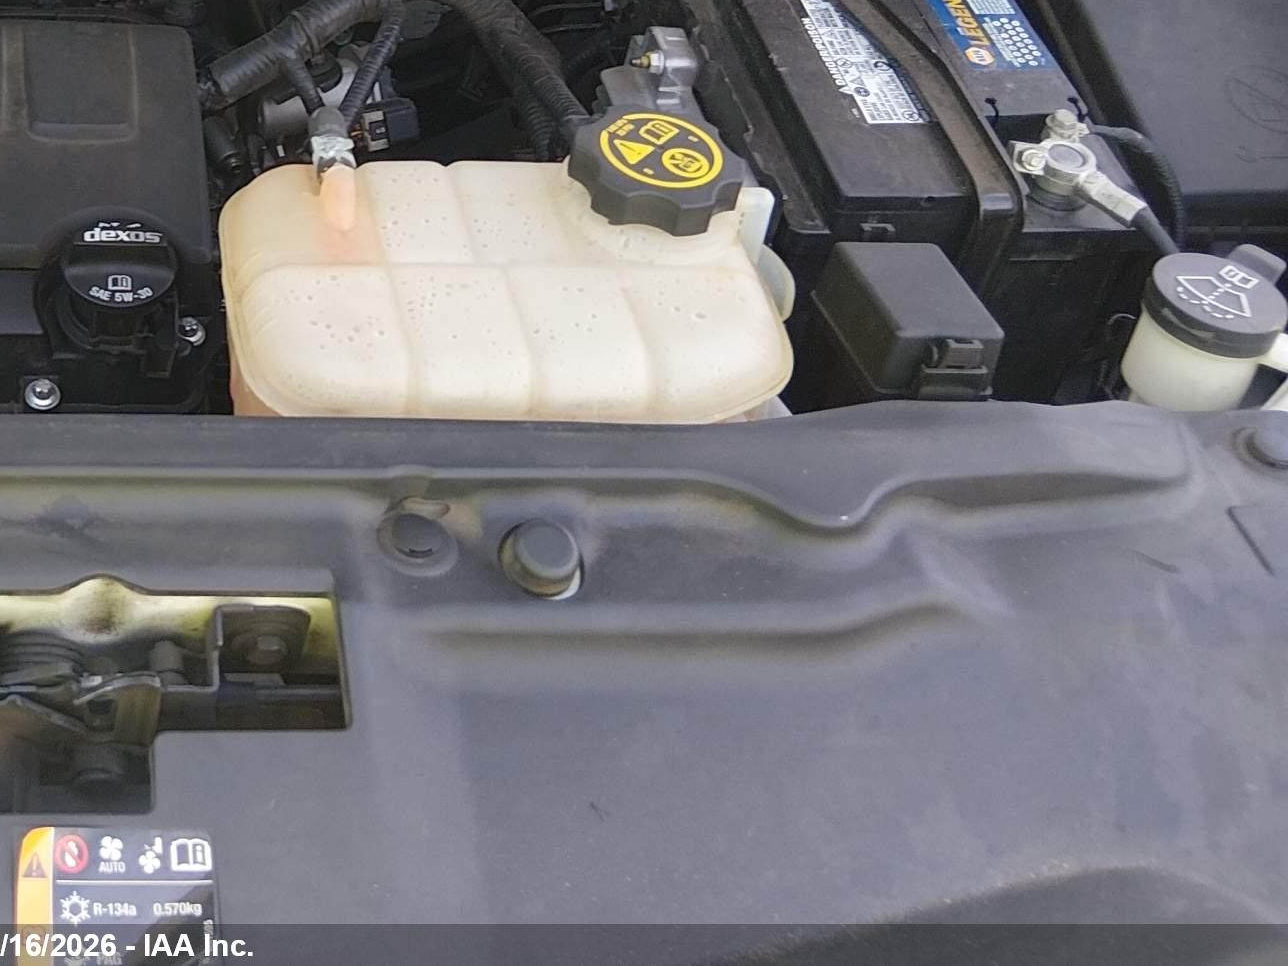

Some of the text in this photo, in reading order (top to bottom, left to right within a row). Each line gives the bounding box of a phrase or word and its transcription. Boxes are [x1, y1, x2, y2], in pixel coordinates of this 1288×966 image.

[89, 286, 153, 302] SAE 5W-30
[98, 861, 126, 874] AUTO
[93, 902, 202, 917] R-134a 0.570kg
